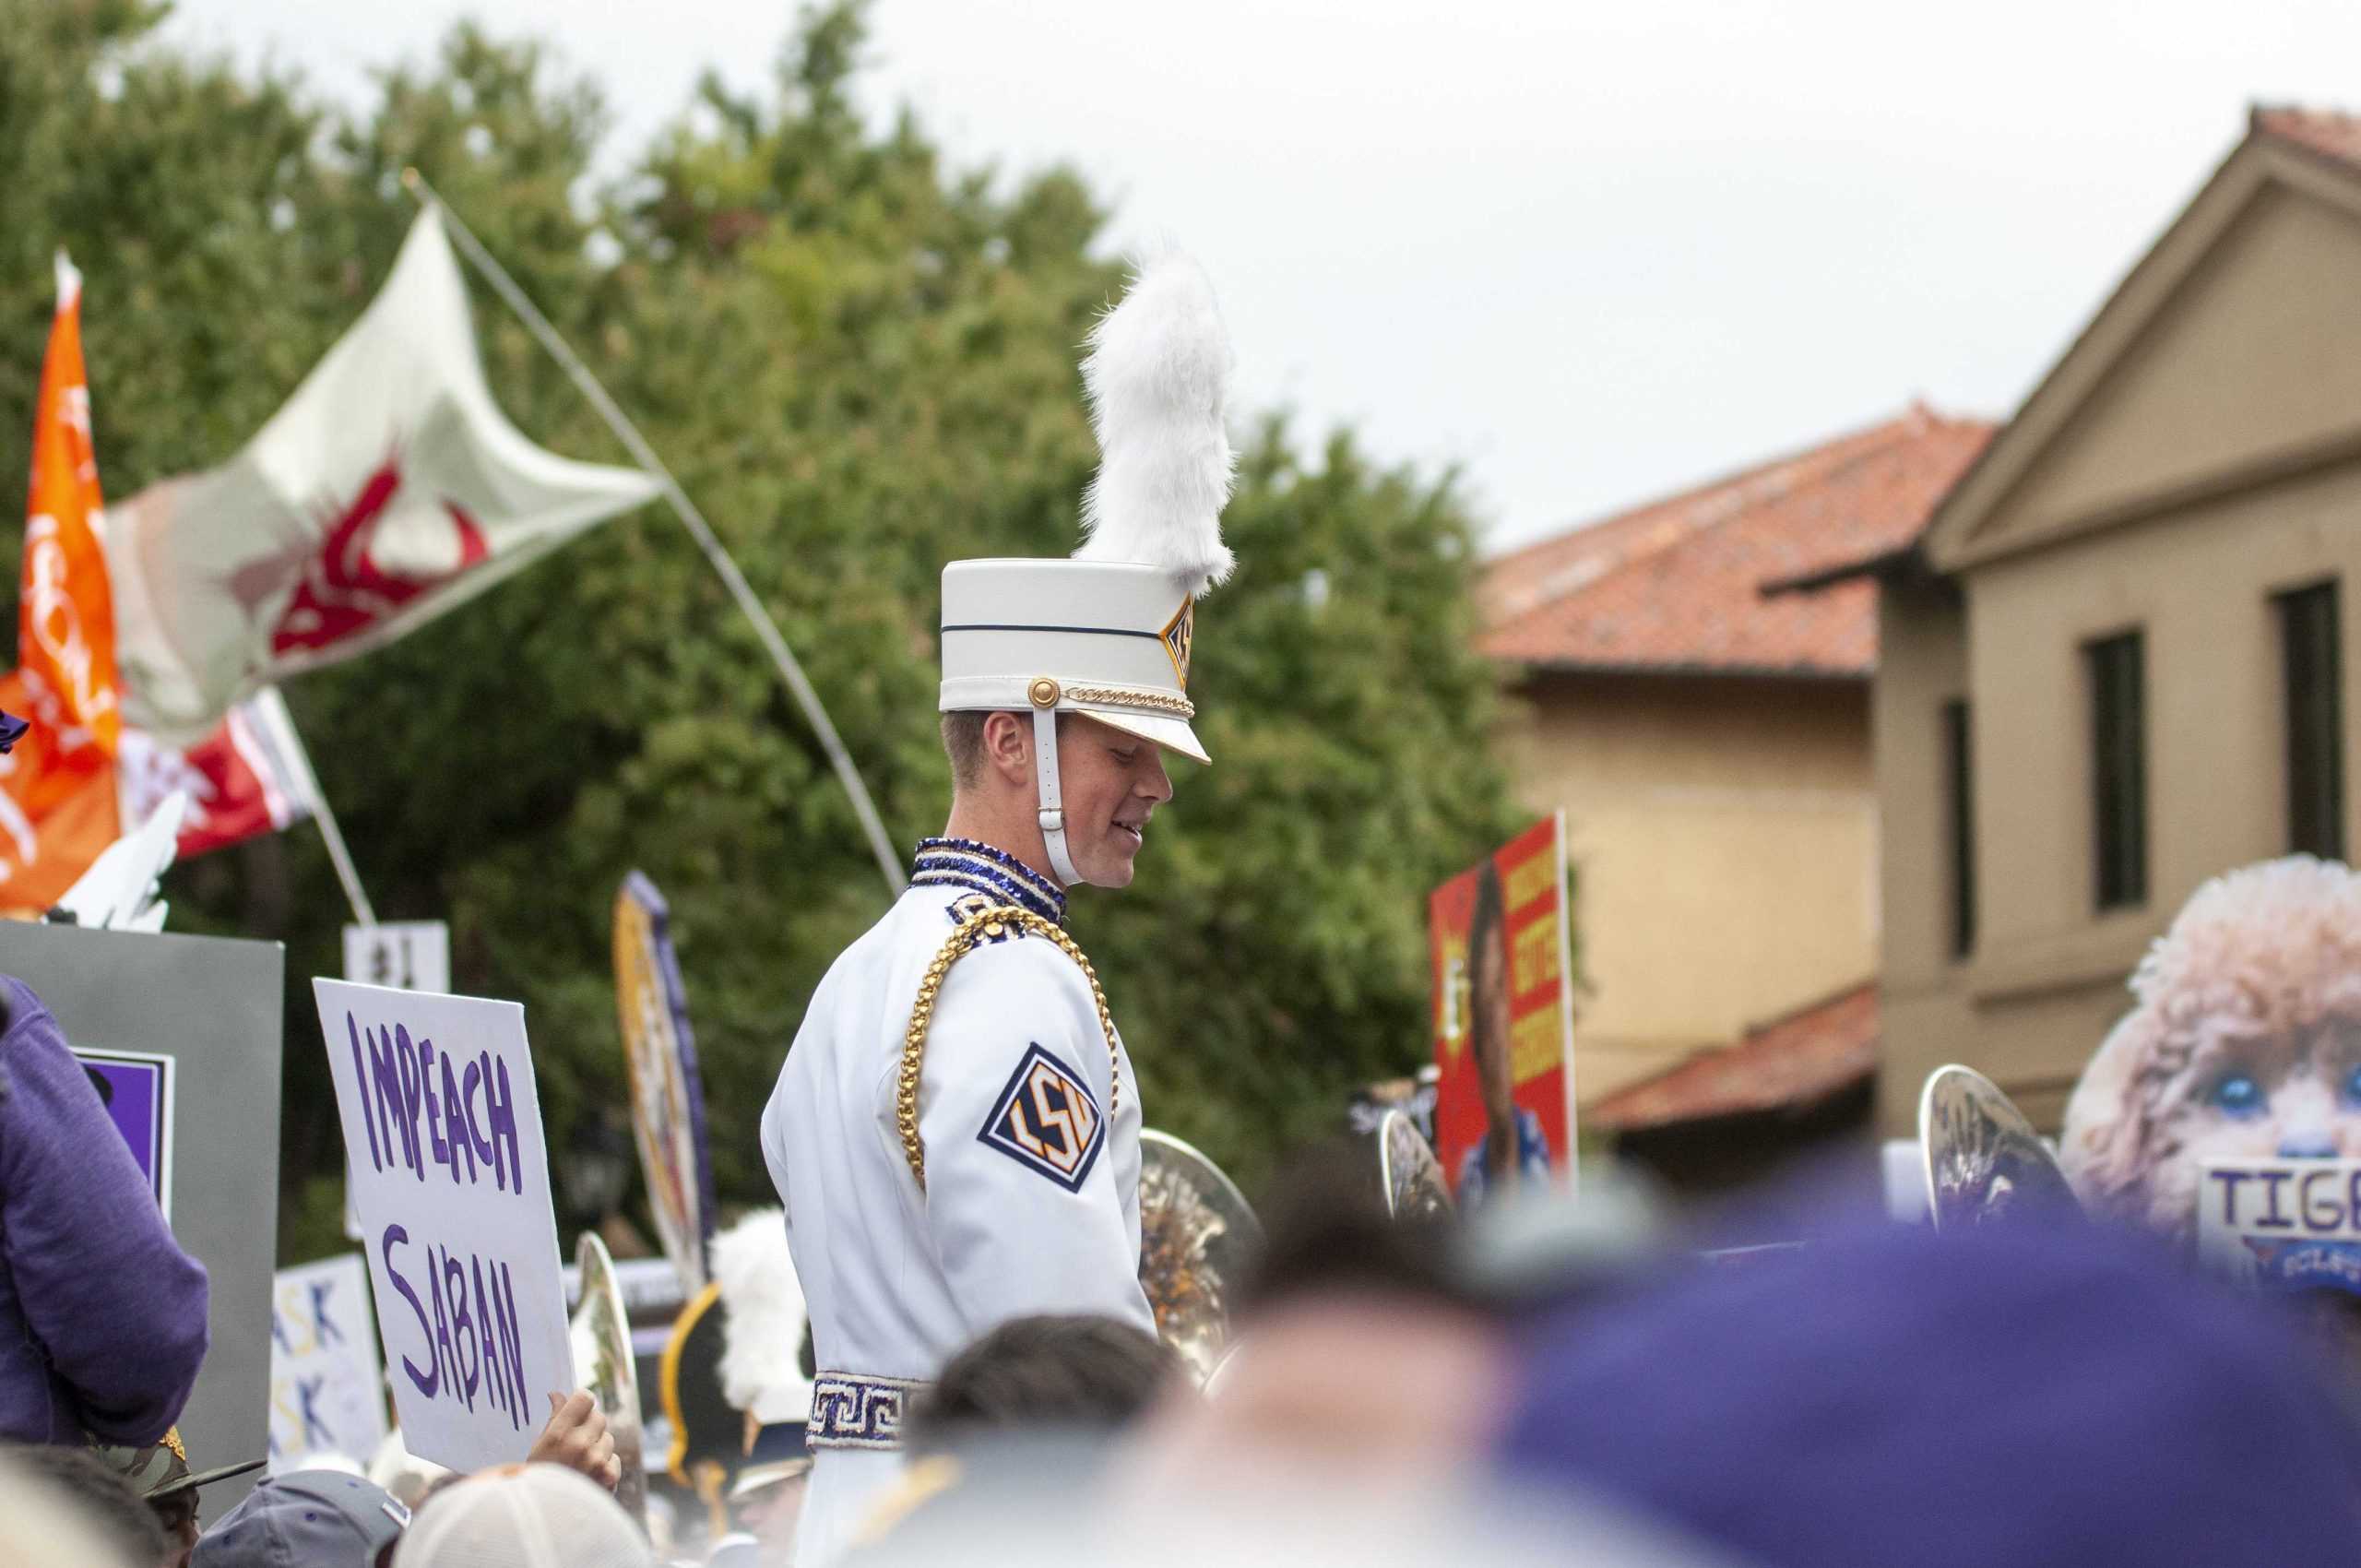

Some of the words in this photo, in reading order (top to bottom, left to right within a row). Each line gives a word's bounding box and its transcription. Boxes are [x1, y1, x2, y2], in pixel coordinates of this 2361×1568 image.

[347, 1010, 522, 1195] IMPEACH
[1009, 1063, 1096, 1172] LSU
[383, 1224, 529, 1431] SABAN
[271, 1374, 336, 1455] SK
